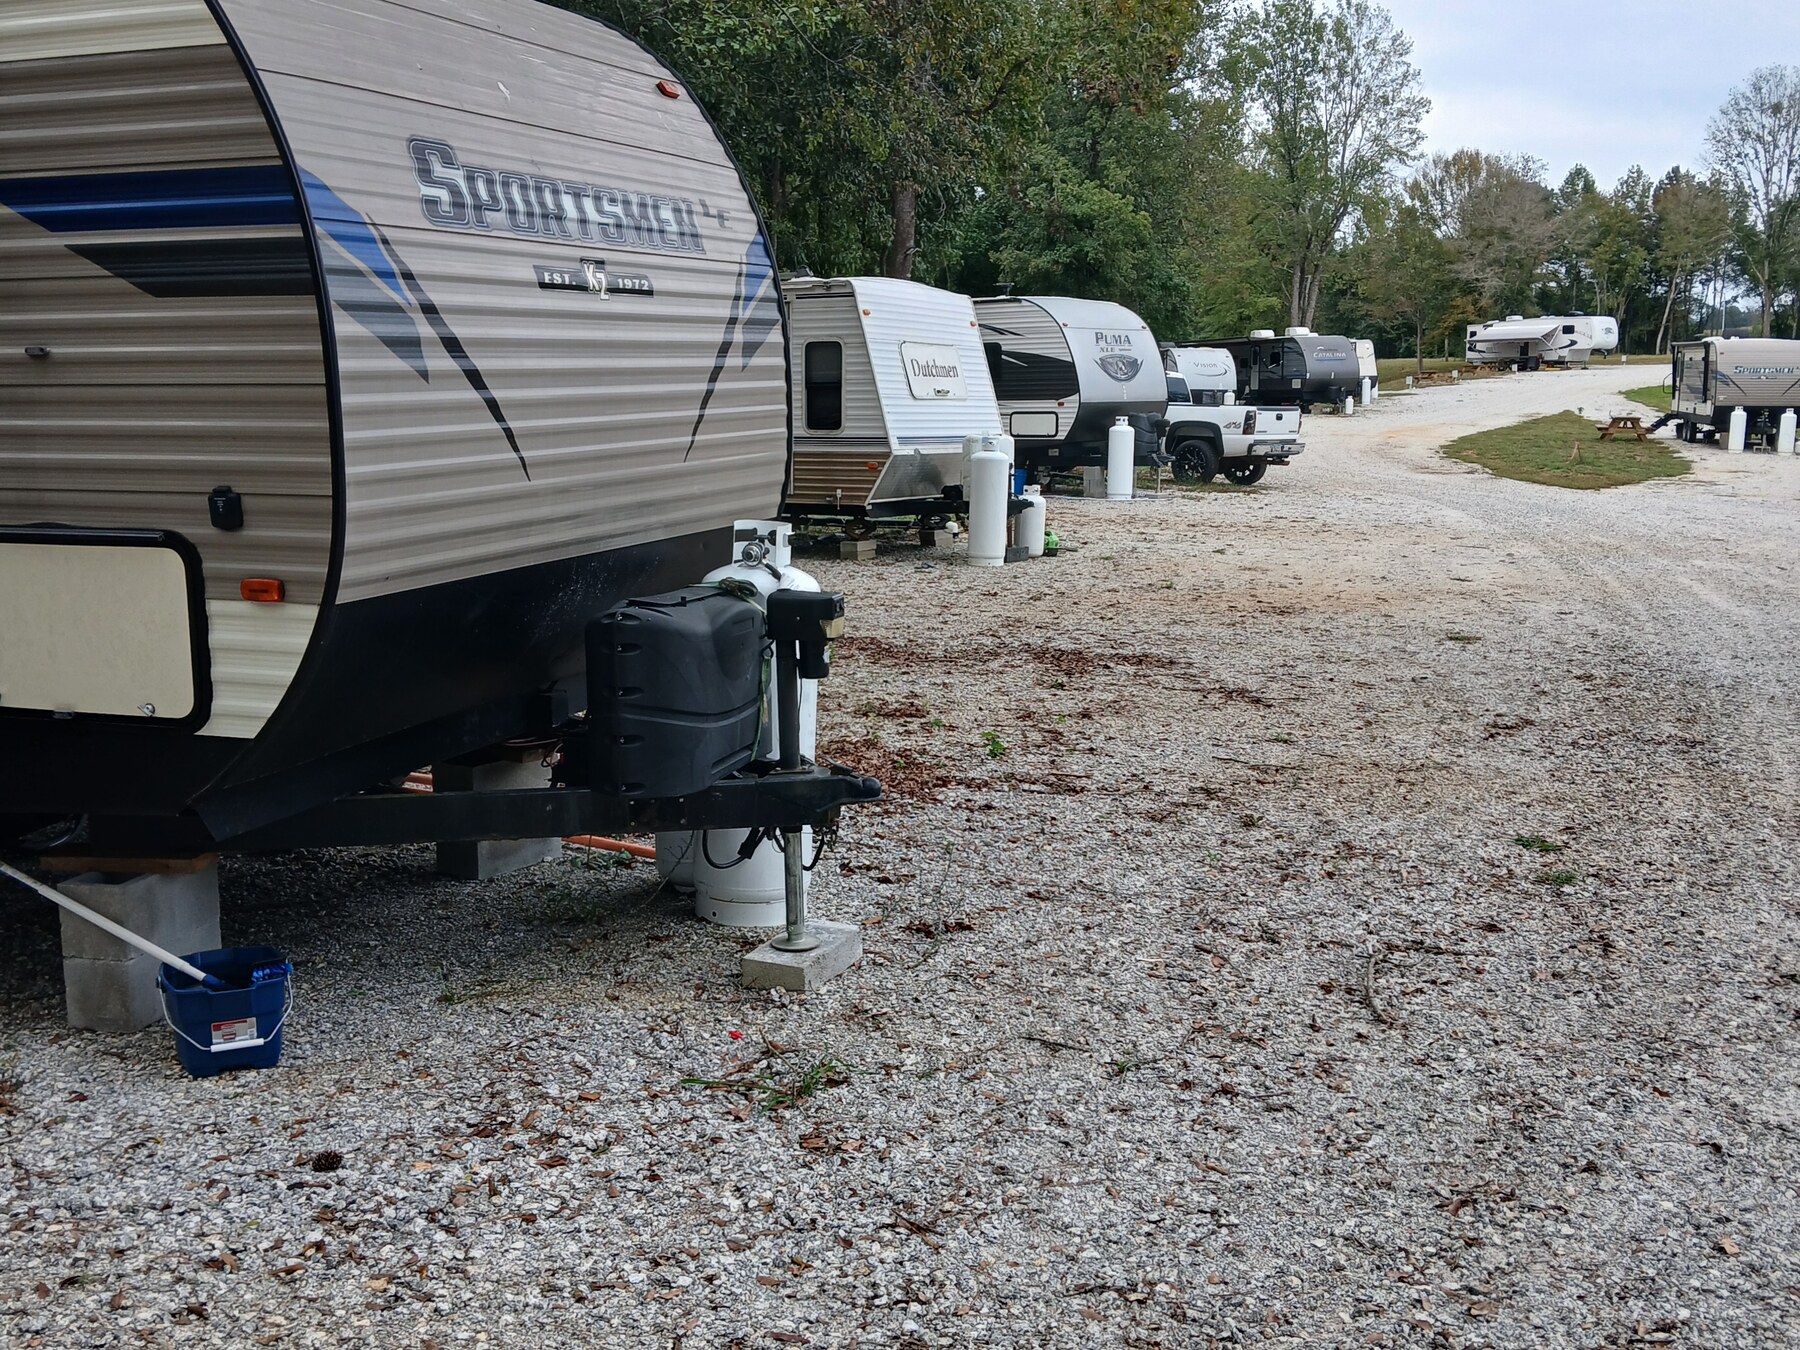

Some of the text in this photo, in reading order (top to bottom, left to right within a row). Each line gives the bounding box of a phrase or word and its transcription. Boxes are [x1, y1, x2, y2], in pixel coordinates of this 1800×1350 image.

[407, 136, 705, 254] SPORTSMEN
[543, 271, 577, 286] EST.
[617, 278, 650, 291] 1972
[1094, 331, 1132, 345] PUMA
[910, 358, 959, 378] Dutchmen
